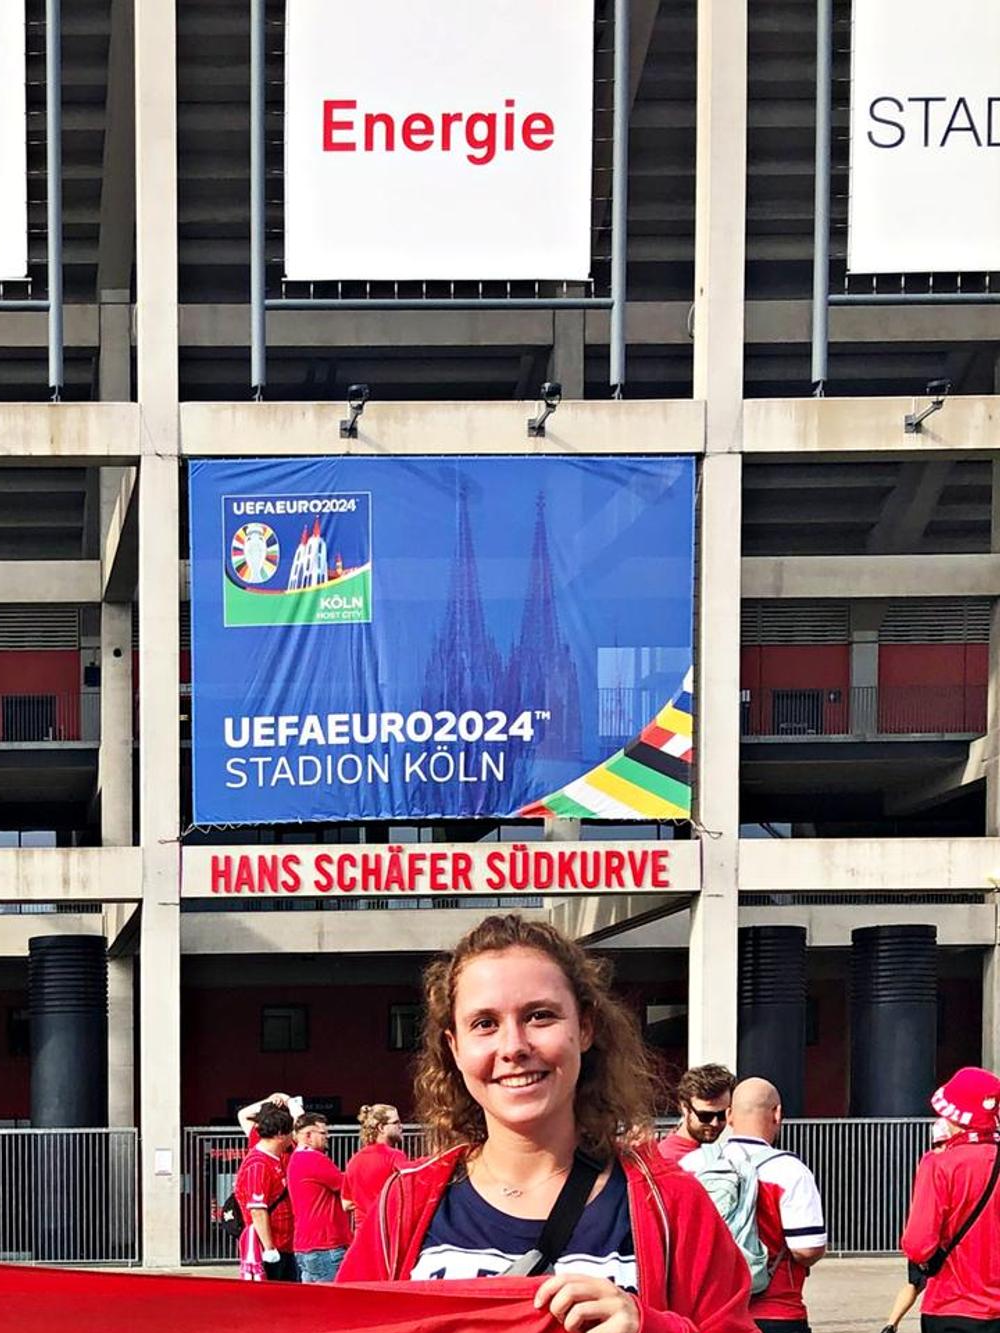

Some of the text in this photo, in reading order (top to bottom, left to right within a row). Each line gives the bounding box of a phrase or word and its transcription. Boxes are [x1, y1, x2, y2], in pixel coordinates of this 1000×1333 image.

[321, 99, 555, 165] Energie
[317, 610, 362, 619] HOST CITY
[319, 595, 364, 610] KÖLN
[225, 746, 504, 789] STADION KÖLN
[211, 844, 670, 893] HANS SCHÄFER SÜDKURVE
